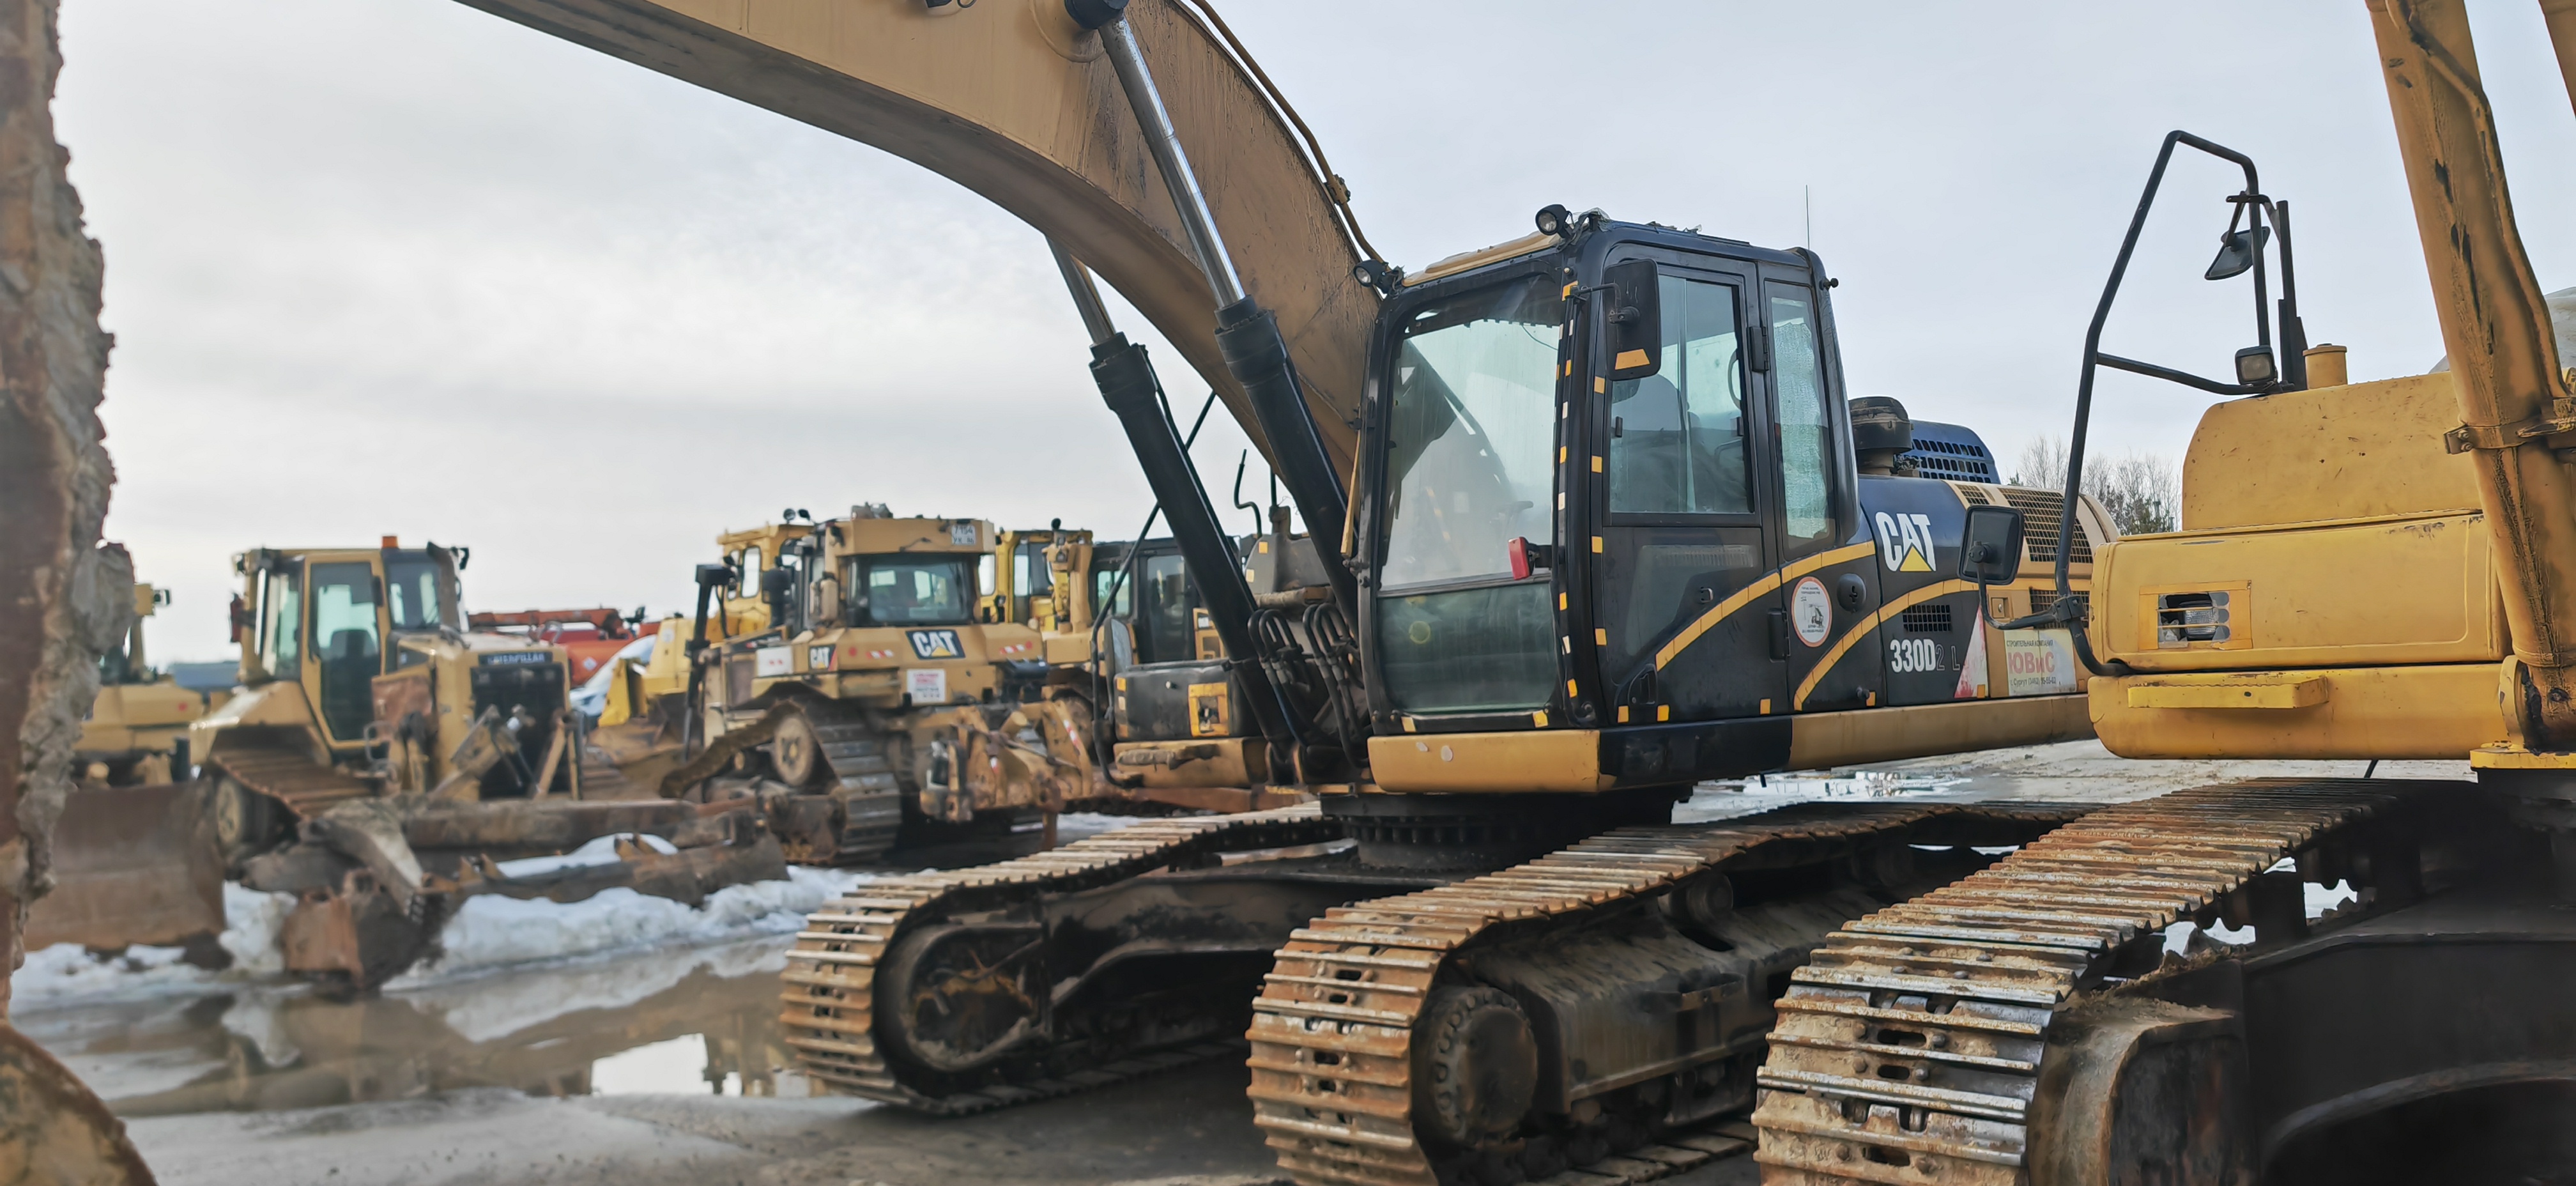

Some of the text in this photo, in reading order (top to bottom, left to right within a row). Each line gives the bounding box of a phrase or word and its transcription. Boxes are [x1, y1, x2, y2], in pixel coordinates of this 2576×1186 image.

[1875, 512, 1936, 571] CAT
[912, 631, 958, 657] CAT
[810, 647, 830, 669] CAT
[2013, 678, 2028, 688] Сургут
